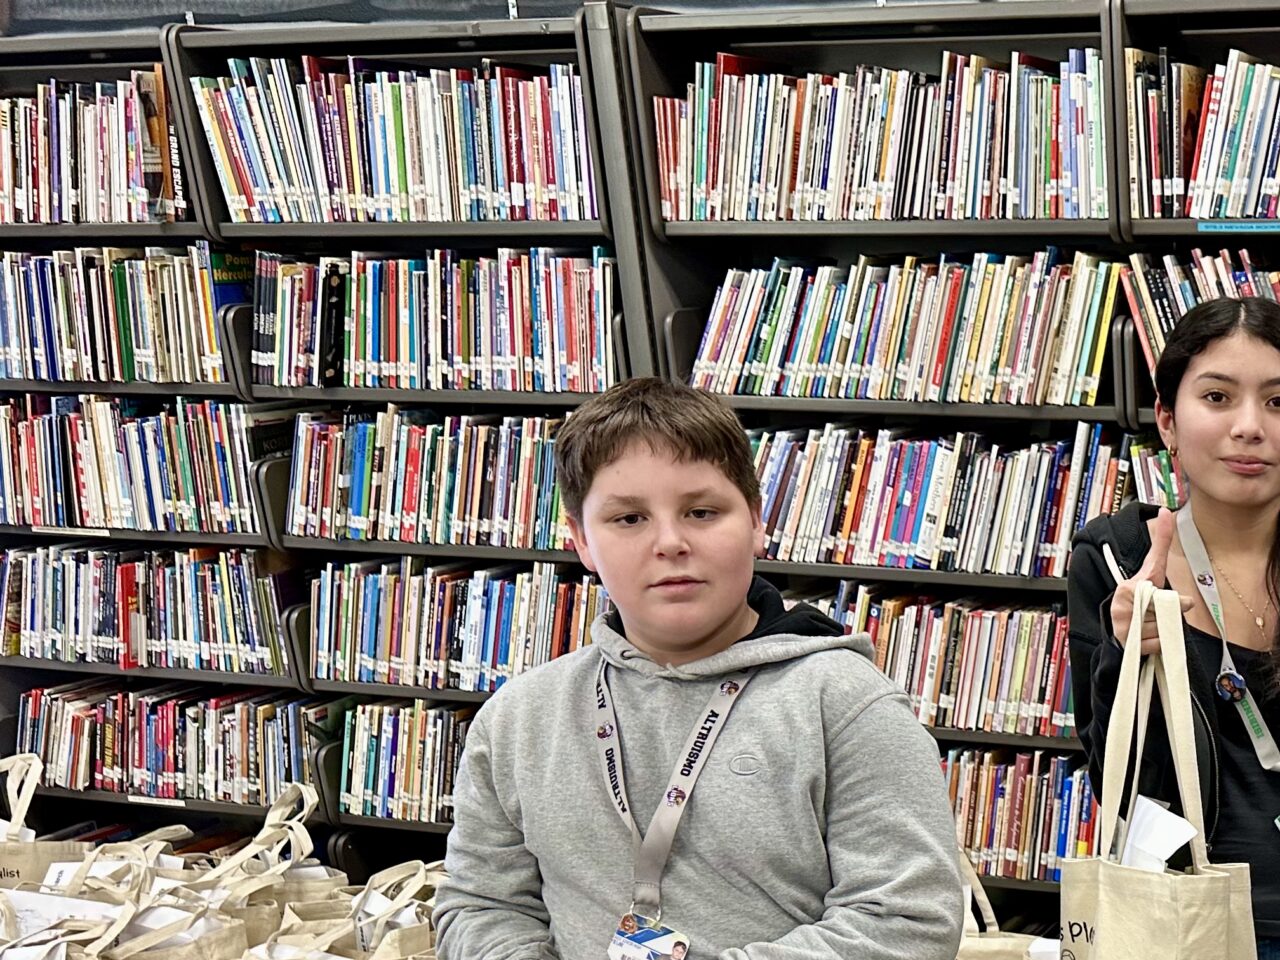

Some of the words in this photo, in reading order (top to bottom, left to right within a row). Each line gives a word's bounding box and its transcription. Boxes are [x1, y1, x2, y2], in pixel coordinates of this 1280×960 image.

[168, 135, 180, 166] GRAND
[937, 452, 949, 473] First
[929, 475, 944, 512] Mothers
[1241, 699, 1265, 739] ISIBIND
[680, 709, 720, 777] ALTRUISMO
[604, 747, 627, 813] ALTRUISMO
